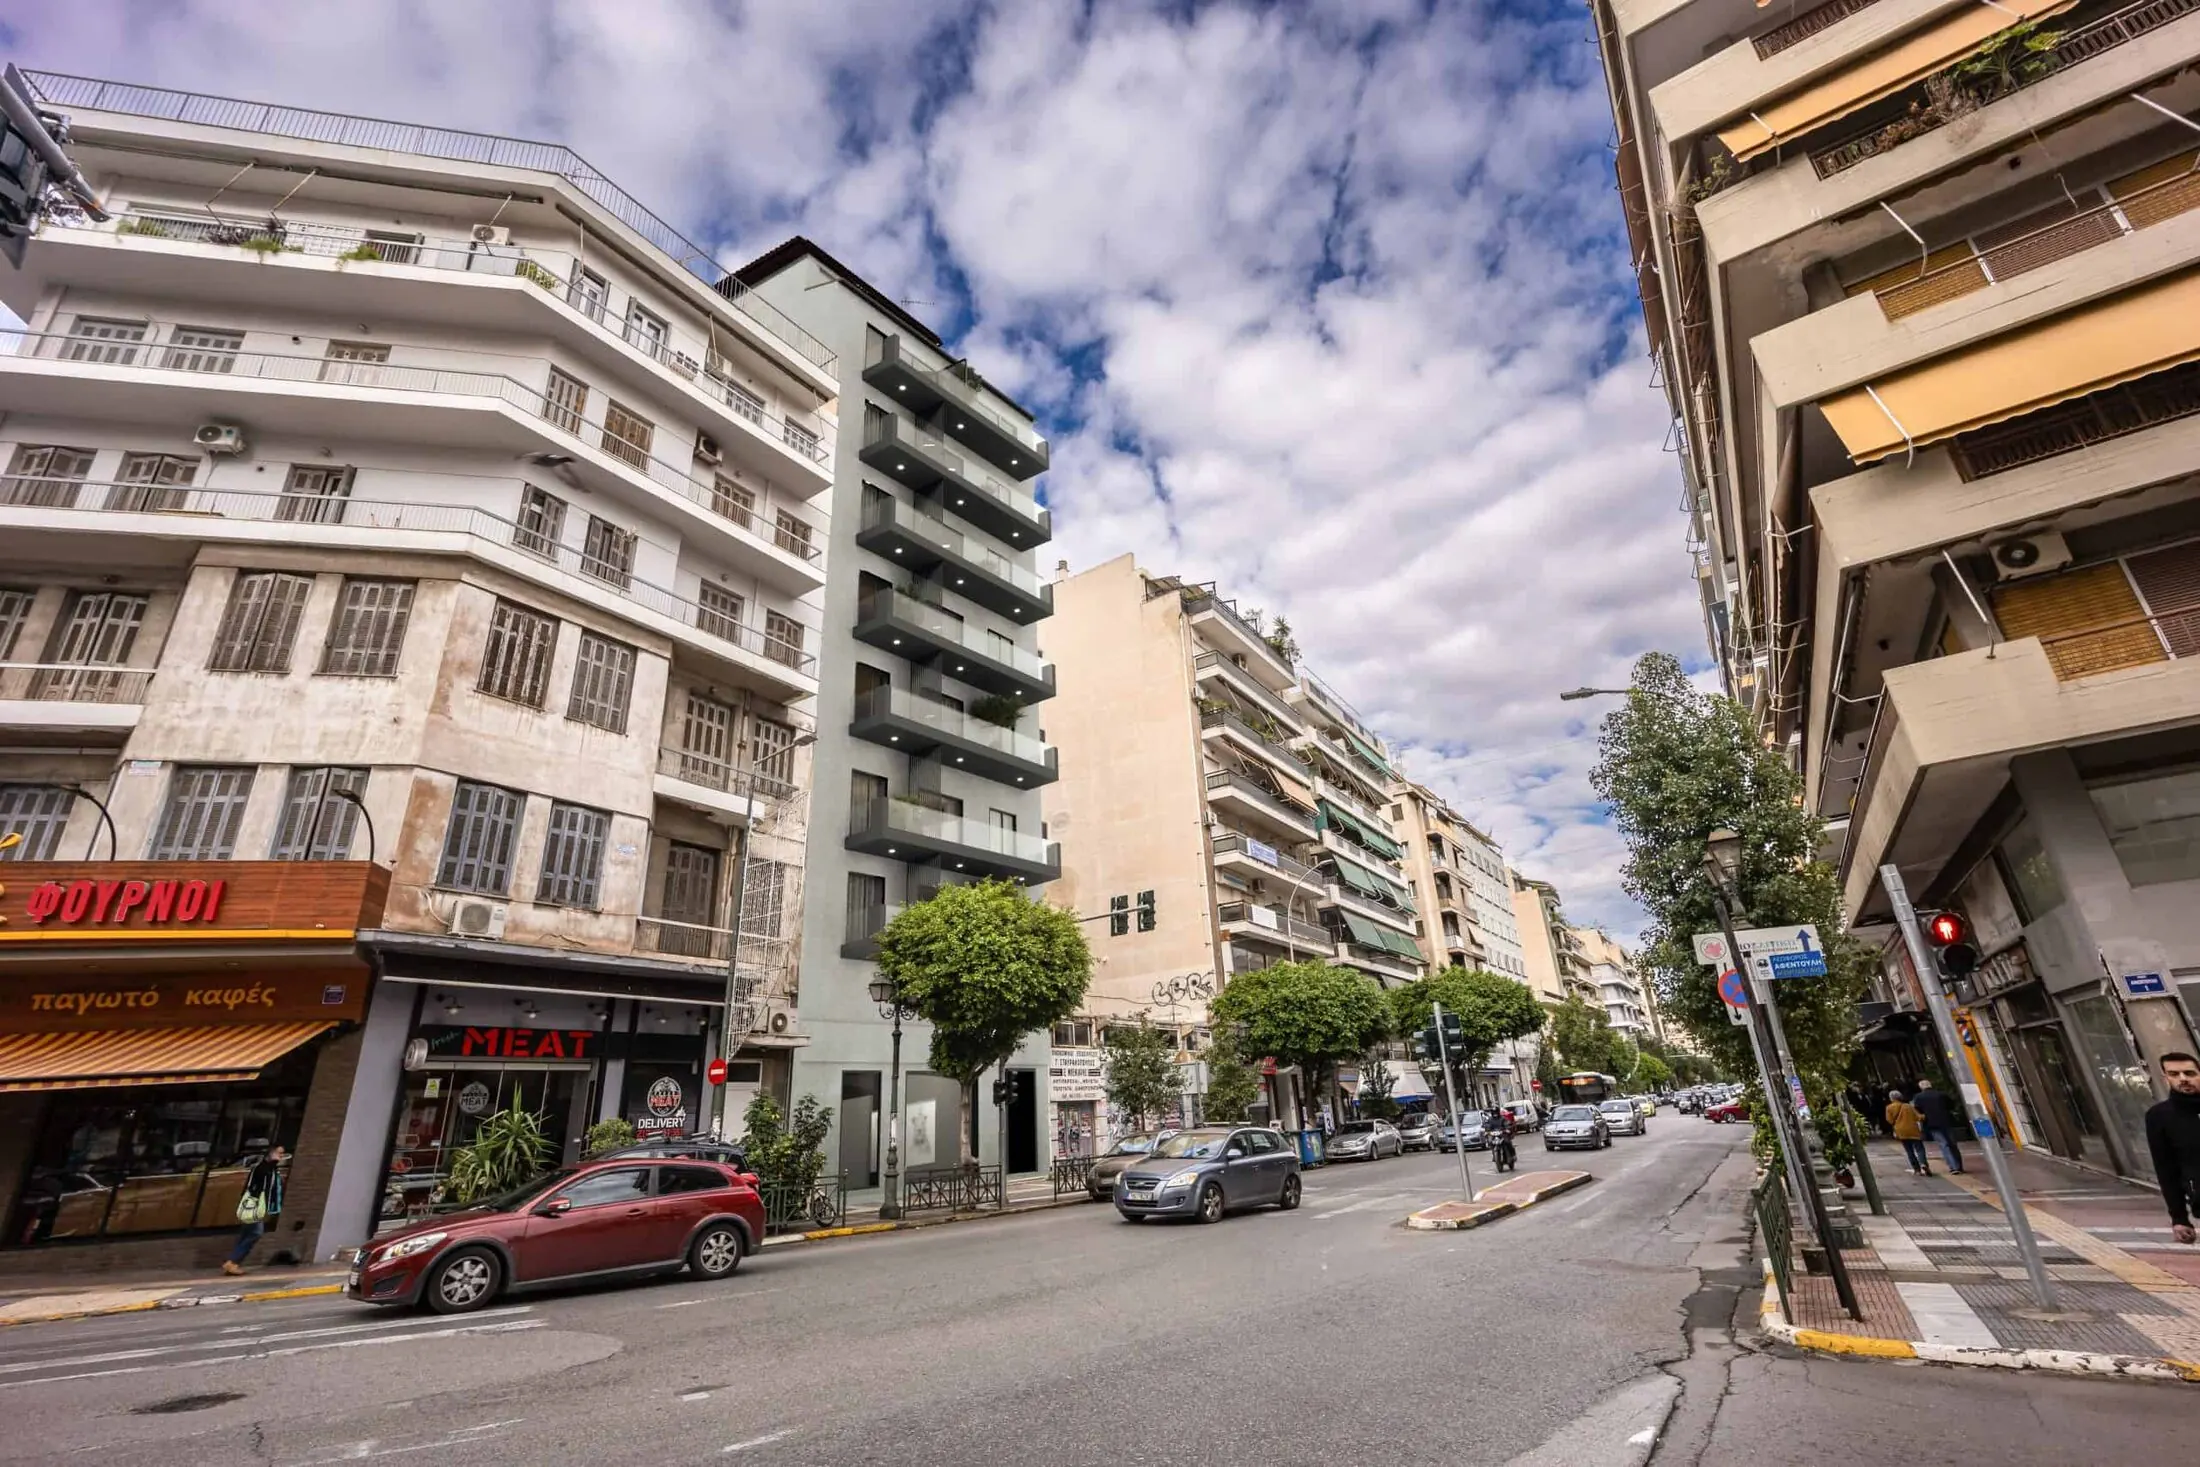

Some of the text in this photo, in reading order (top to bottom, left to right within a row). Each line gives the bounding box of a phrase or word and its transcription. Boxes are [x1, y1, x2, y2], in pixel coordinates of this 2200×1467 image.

[26, 880, 226, 924] ΦΟΥΡΝΟΙ
[1774, 959, 1822, 970] ΑΦΕΝΤΟΥΛΗ
[31, 981, 277, 1015] παγωτό καφές
[462, 1026, 593, 1058] MEAT
[461, 1097, 487, 1106] MEAT
[650, 1093, 680, 1107] MEAT
[638, 1117, 684, 1129] DELIVERY
